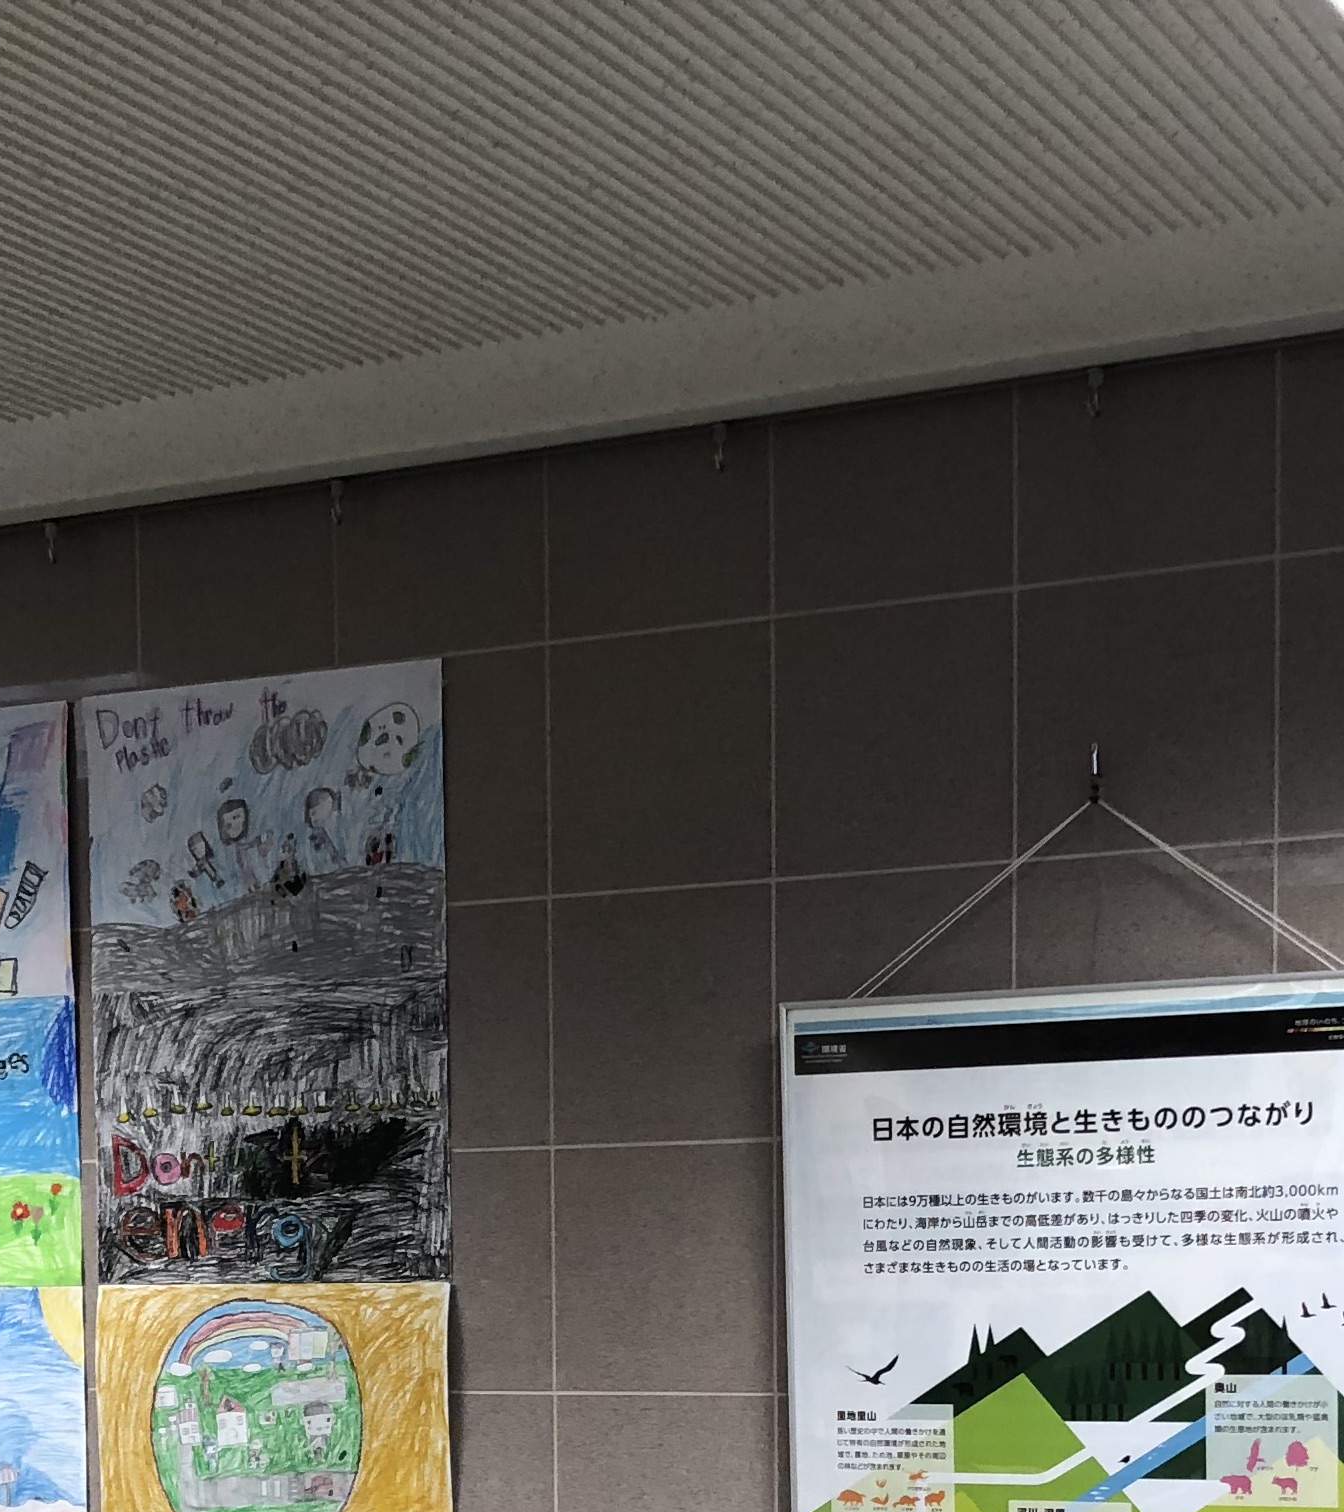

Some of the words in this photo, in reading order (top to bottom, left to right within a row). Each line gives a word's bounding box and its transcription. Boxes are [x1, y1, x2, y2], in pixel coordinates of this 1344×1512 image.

[871, 1100, 1315, 1142] 日本の自然環境と生きもののつながり
[1016, 1143, 1156, 1168] 生態系の多様性
[863, 1257, 1130, 1275] さまざまな生きものの生活の場となっています。
